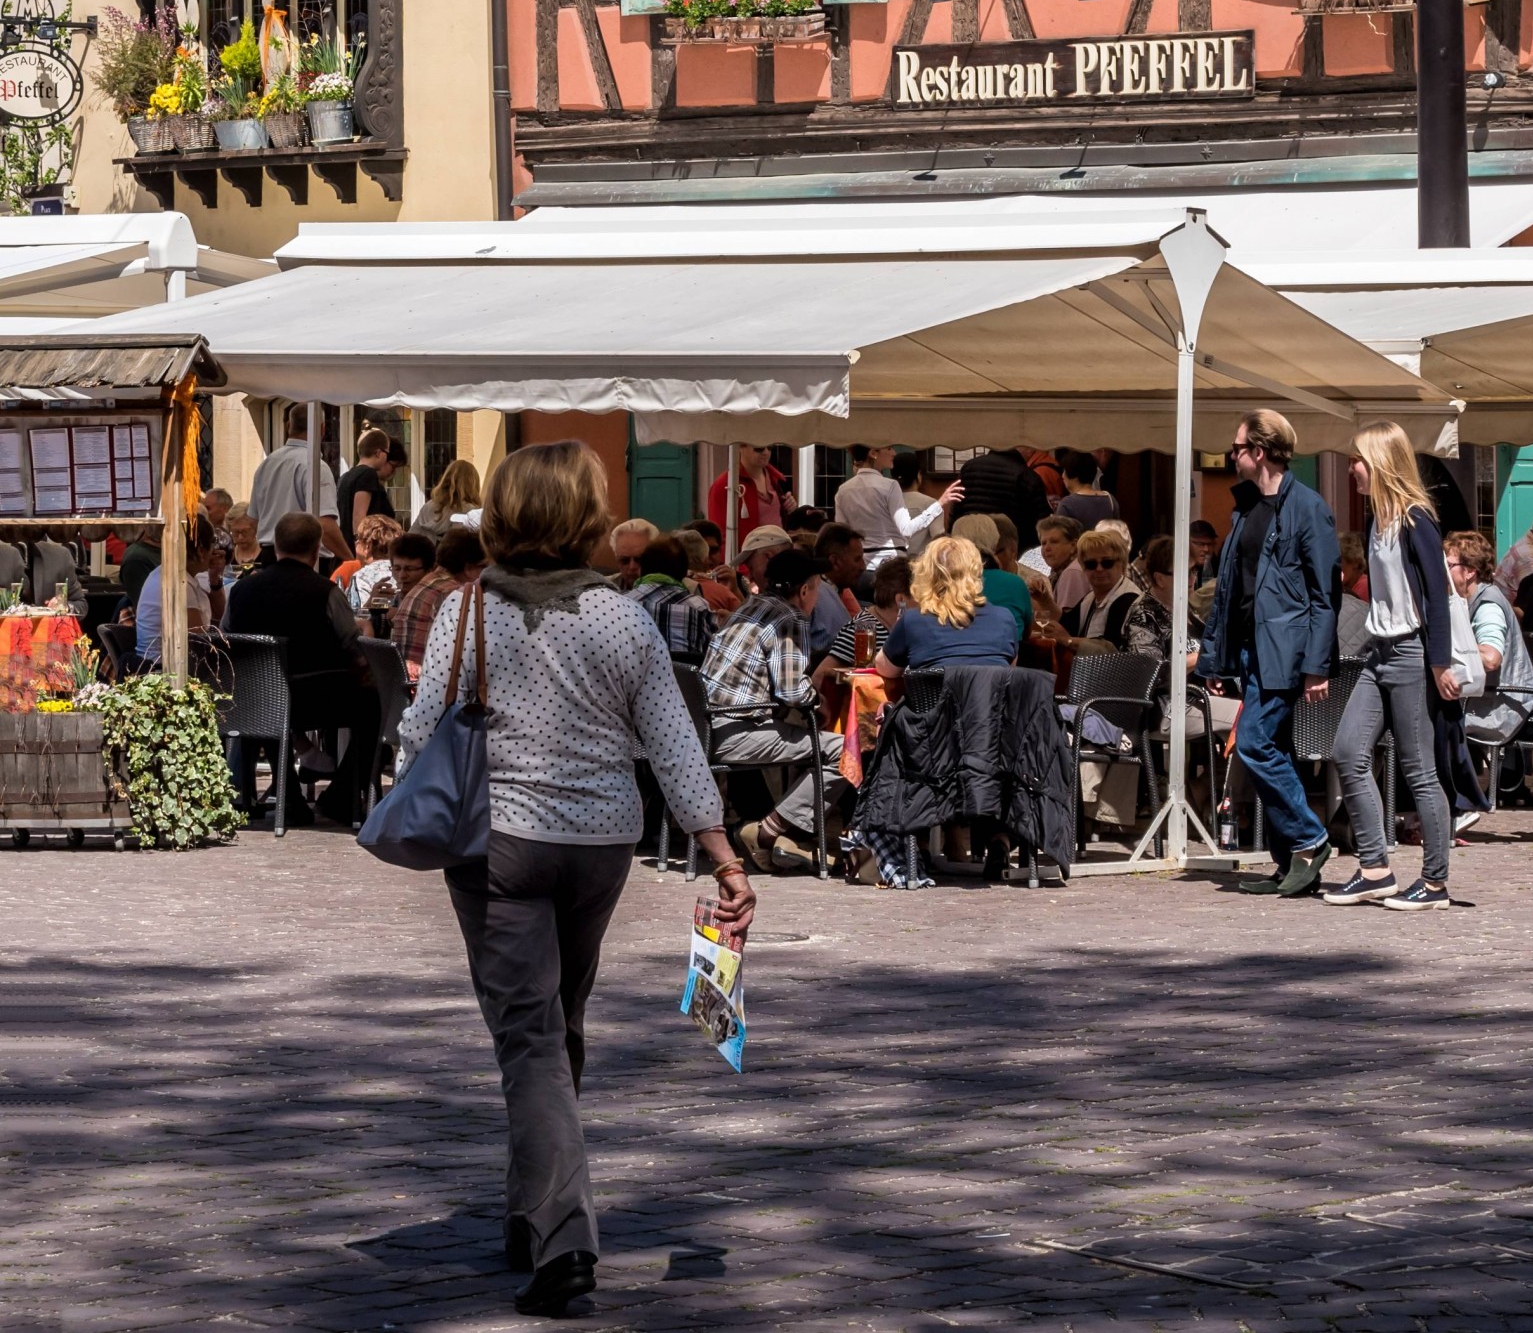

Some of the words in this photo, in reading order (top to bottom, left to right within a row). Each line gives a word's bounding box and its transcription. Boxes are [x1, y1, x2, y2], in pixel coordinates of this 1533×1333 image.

[0, 56, 68, 81] ESTAURANT
[896, 50, 1060, 103] Restaurant
[1066, 36, 1248, 97] PFEFFEL
[0, 79, 59, 101] Pfeffel
